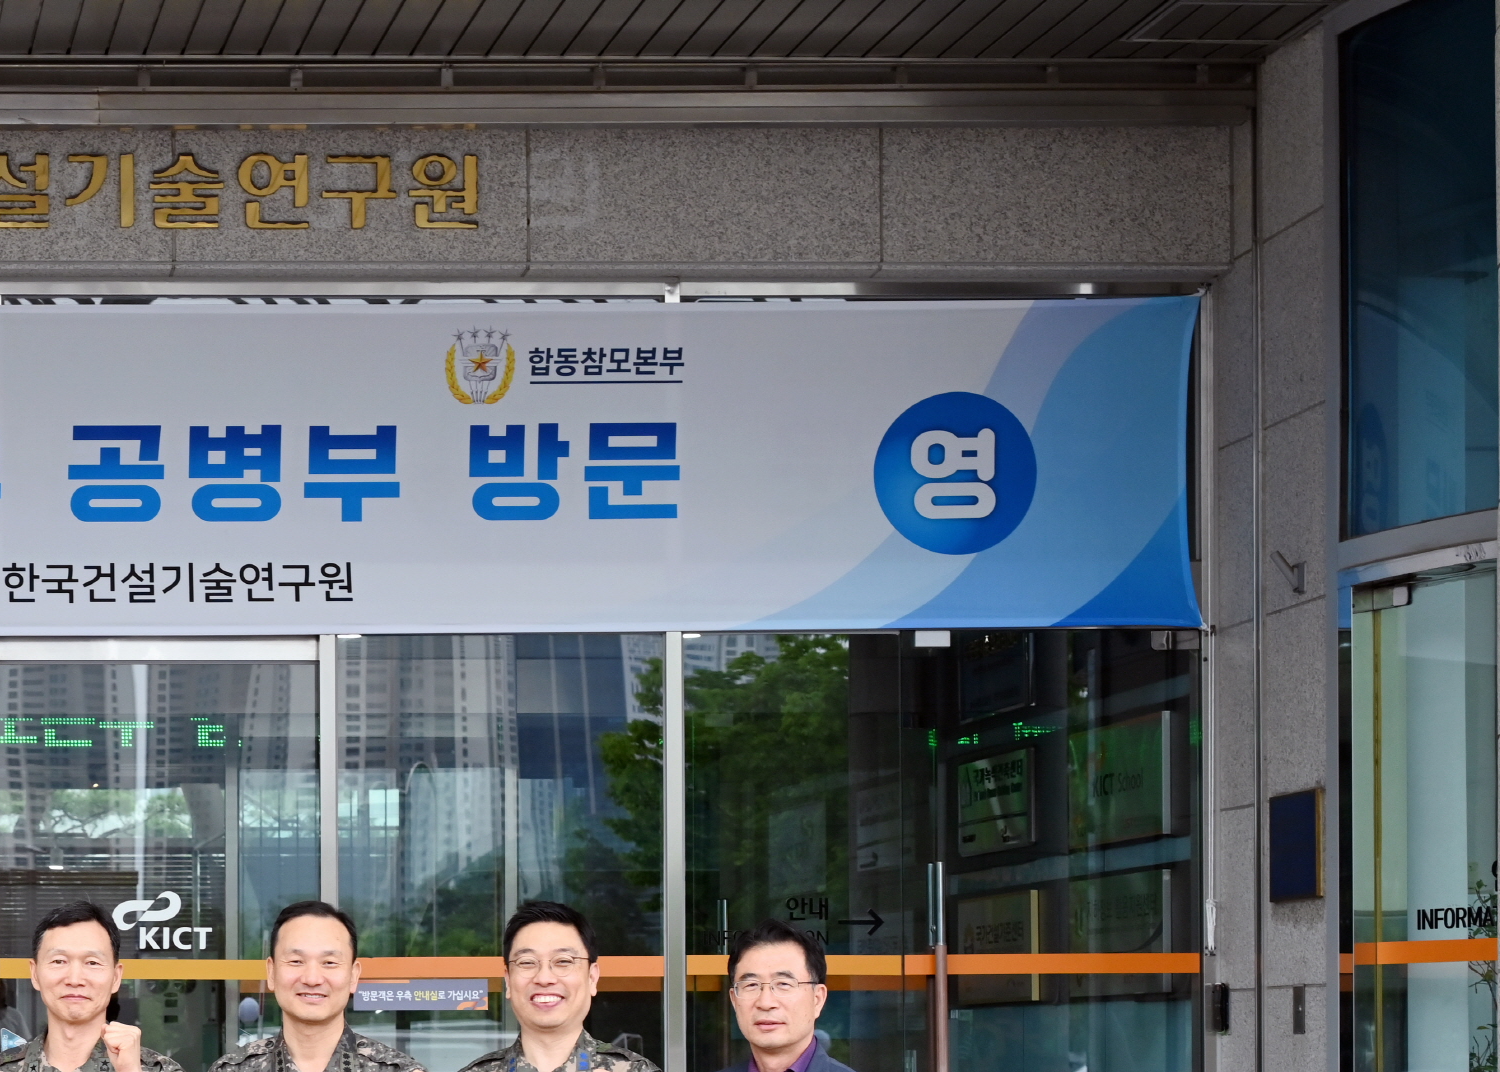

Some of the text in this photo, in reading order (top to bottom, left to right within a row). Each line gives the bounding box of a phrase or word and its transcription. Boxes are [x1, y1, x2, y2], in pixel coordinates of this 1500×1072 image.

[528, 346, 684, 378] 합동참모본부
[68, 424, 400, 522] 공병부
[470, 423, 680, 520] 방문
[911, 429, 996, 519] 영
[3, 562, 354, 604] 한국건설기술연구원
[1093, 767, 1144, 797] KICT School
[786, 897, 829, 921] 안내
[139, 927, 213, 950] KICT
[395, 990, 413, 1001] 우측
[413, 990, 447, 1001] 안내실로
